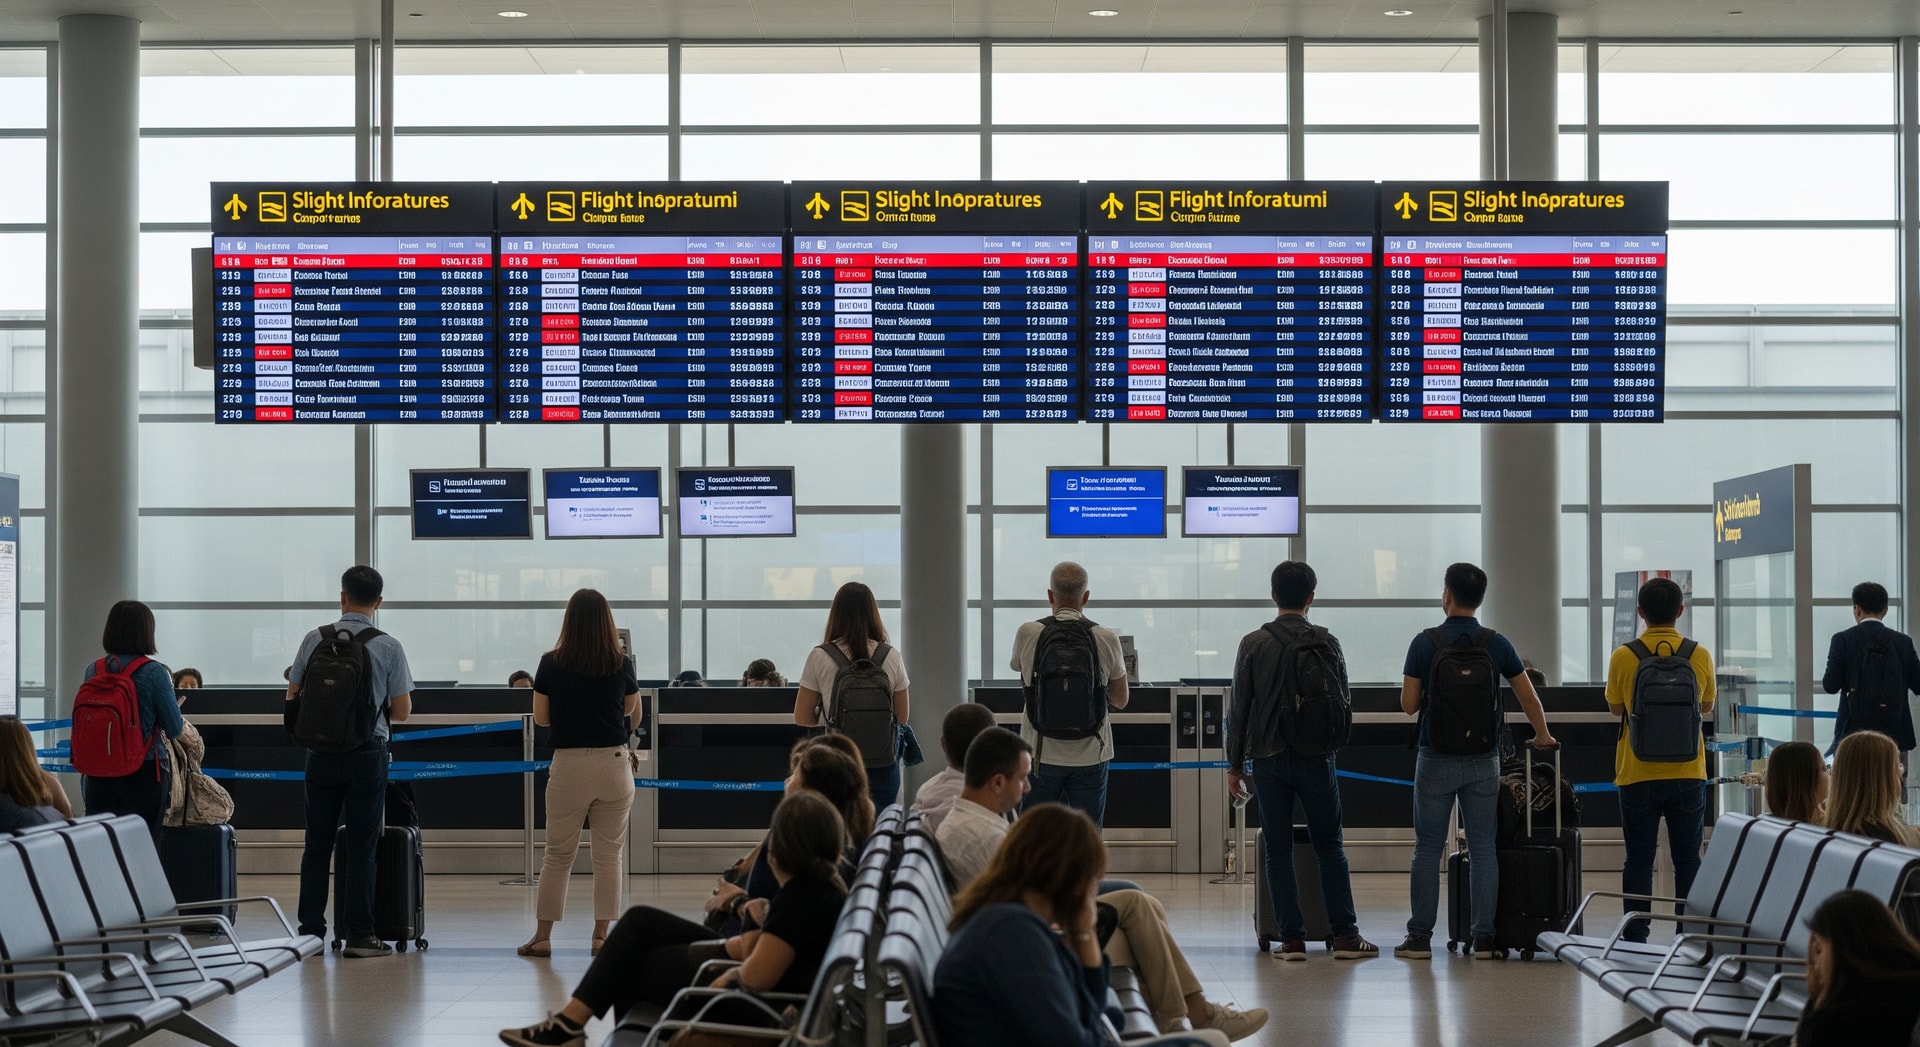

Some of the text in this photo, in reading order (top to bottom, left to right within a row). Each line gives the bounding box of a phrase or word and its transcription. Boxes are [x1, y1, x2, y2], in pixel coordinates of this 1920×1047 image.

[293, 191, 449, 213] Slight Inforatures
[581, 191, 633, 212] Flight
[875, 190, 930, 212] Slight
[1170, 190, 1327, 212] Flight Inforatumi
[1463, 190, 1517, 212] Slight
